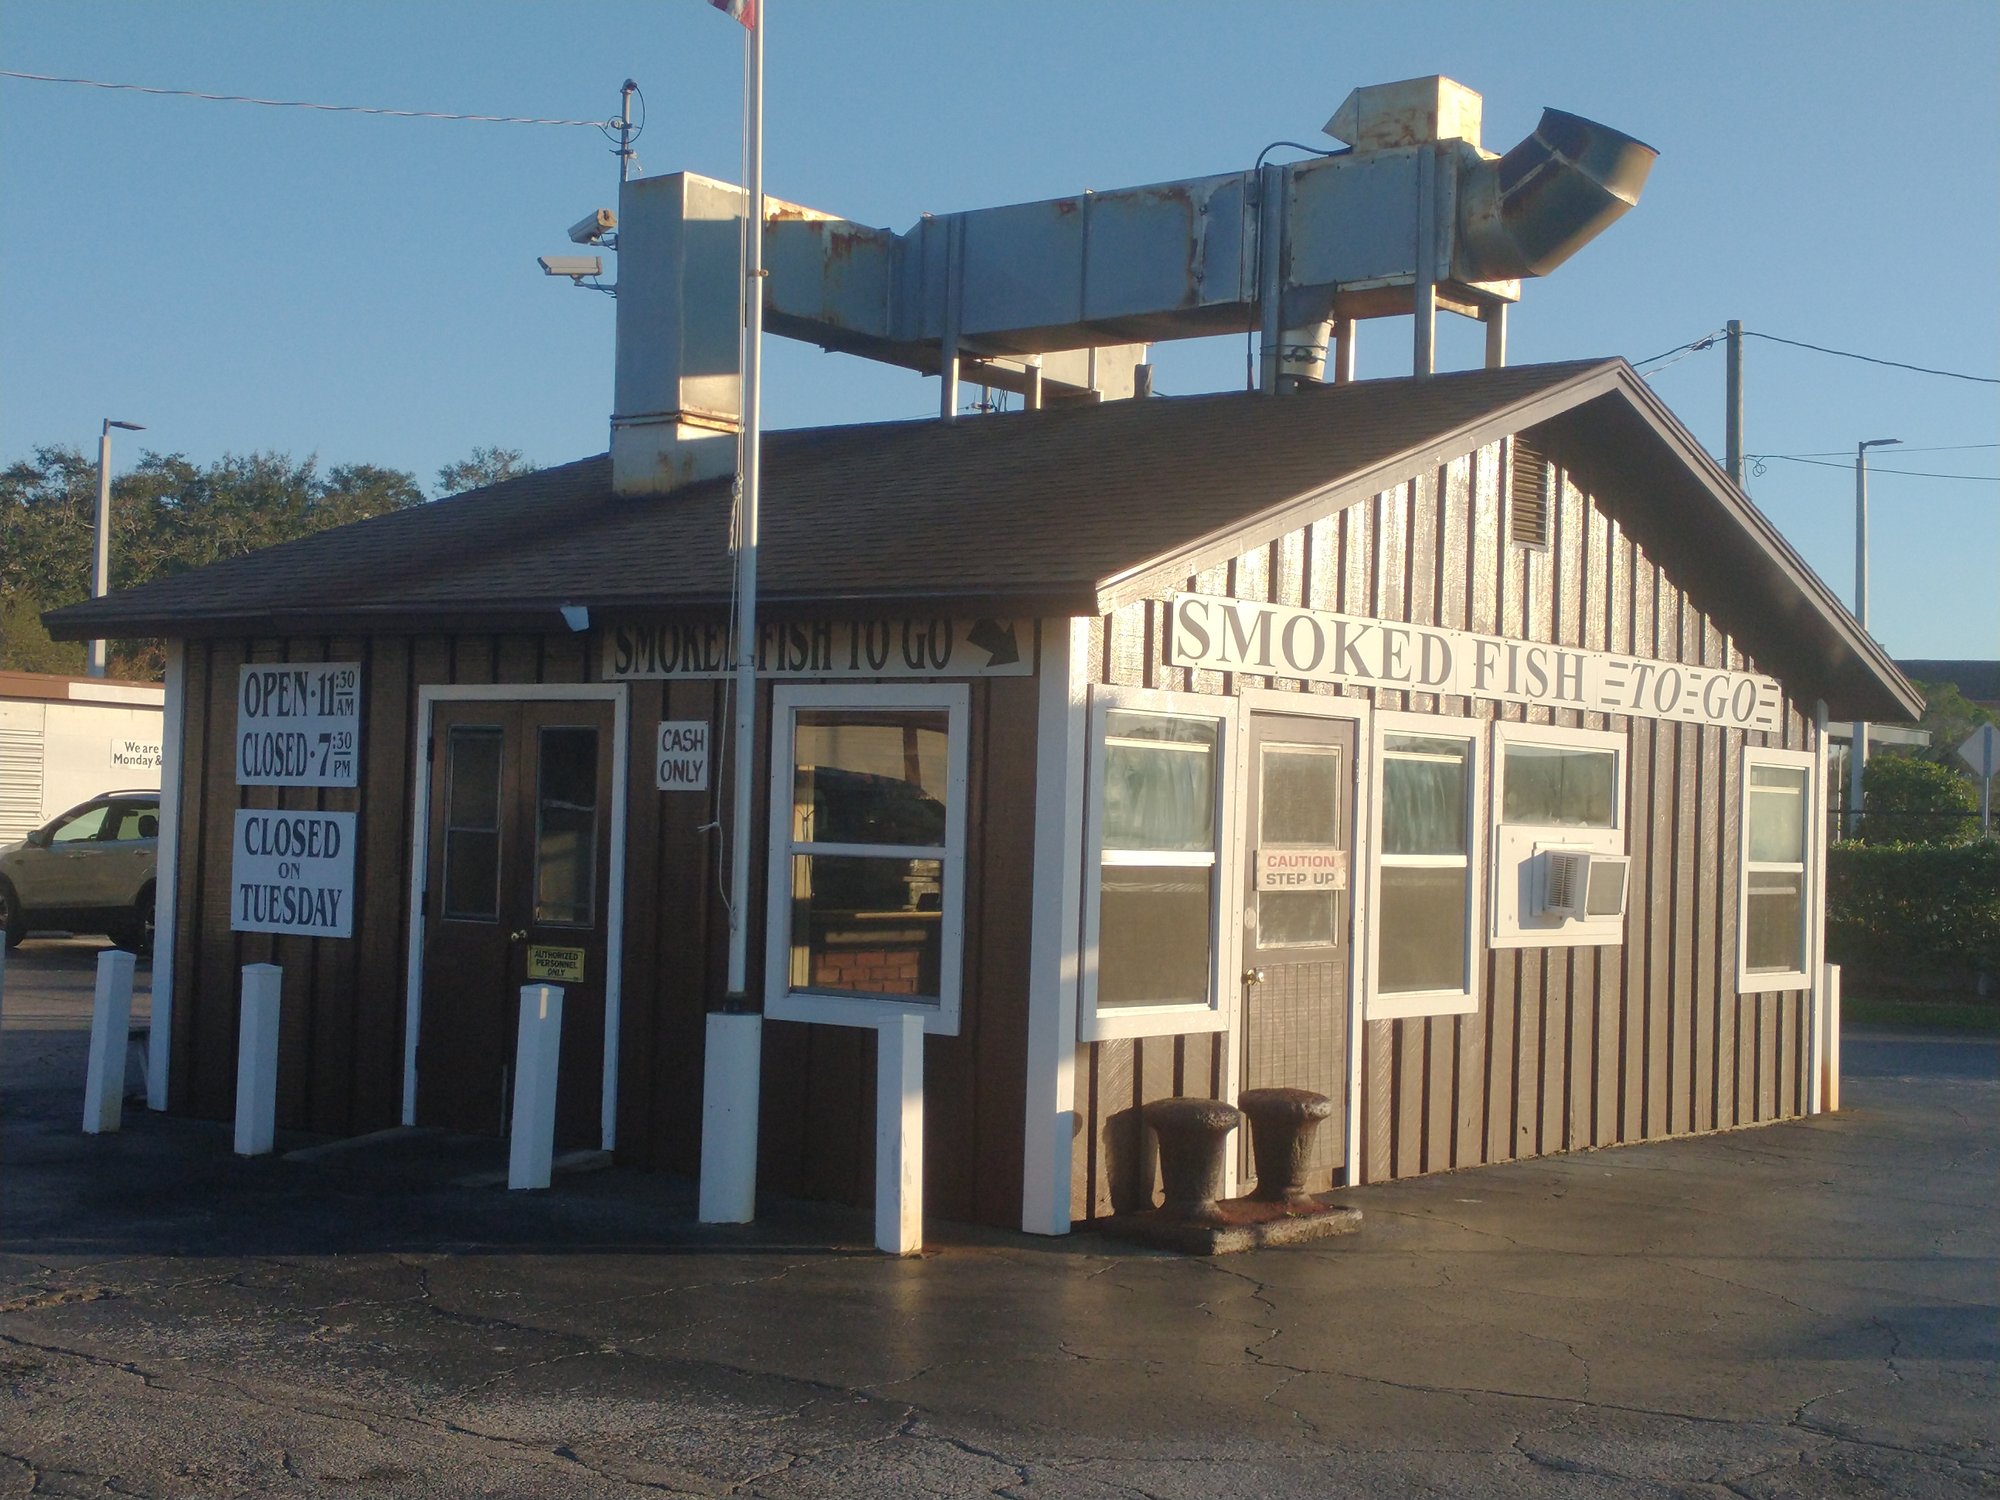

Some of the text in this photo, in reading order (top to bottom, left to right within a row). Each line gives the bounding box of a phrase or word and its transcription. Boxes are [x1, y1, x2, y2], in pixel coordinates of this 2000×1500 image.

[756, 620, 832, 672] FISH
[844, 617, 890, 671] TO
[902, 617, 953, 670] GO
[1177, 598, 1757, 723] SMOKED FISH TO GO
[244, 671, 309, 718] OPEN
[336, 698, 354, 717] AM
[124, 741, 140, 753] We
[662, 728, 704, 752] CASH
[114, 753, 153, 768] Monday
[242, 732, 308, 777] CLOSED
[333, 760, 351, 778] PM
[660, 759, 703, 783] ONLY
[245, 816, 341, 859] CLOSED
[1266, 855, 1335, 867] CAUTION
[278, 862, 301, 879] ON
[1266, 873, 1335, 885] STEP UP
[240, 883, 343, 928] TUESDAY
[535, 951, 578, 960] AUTHORIZED
[536, 960, 577, 969] PERSONNEL
[548, 968, 565, 976] ONLY
